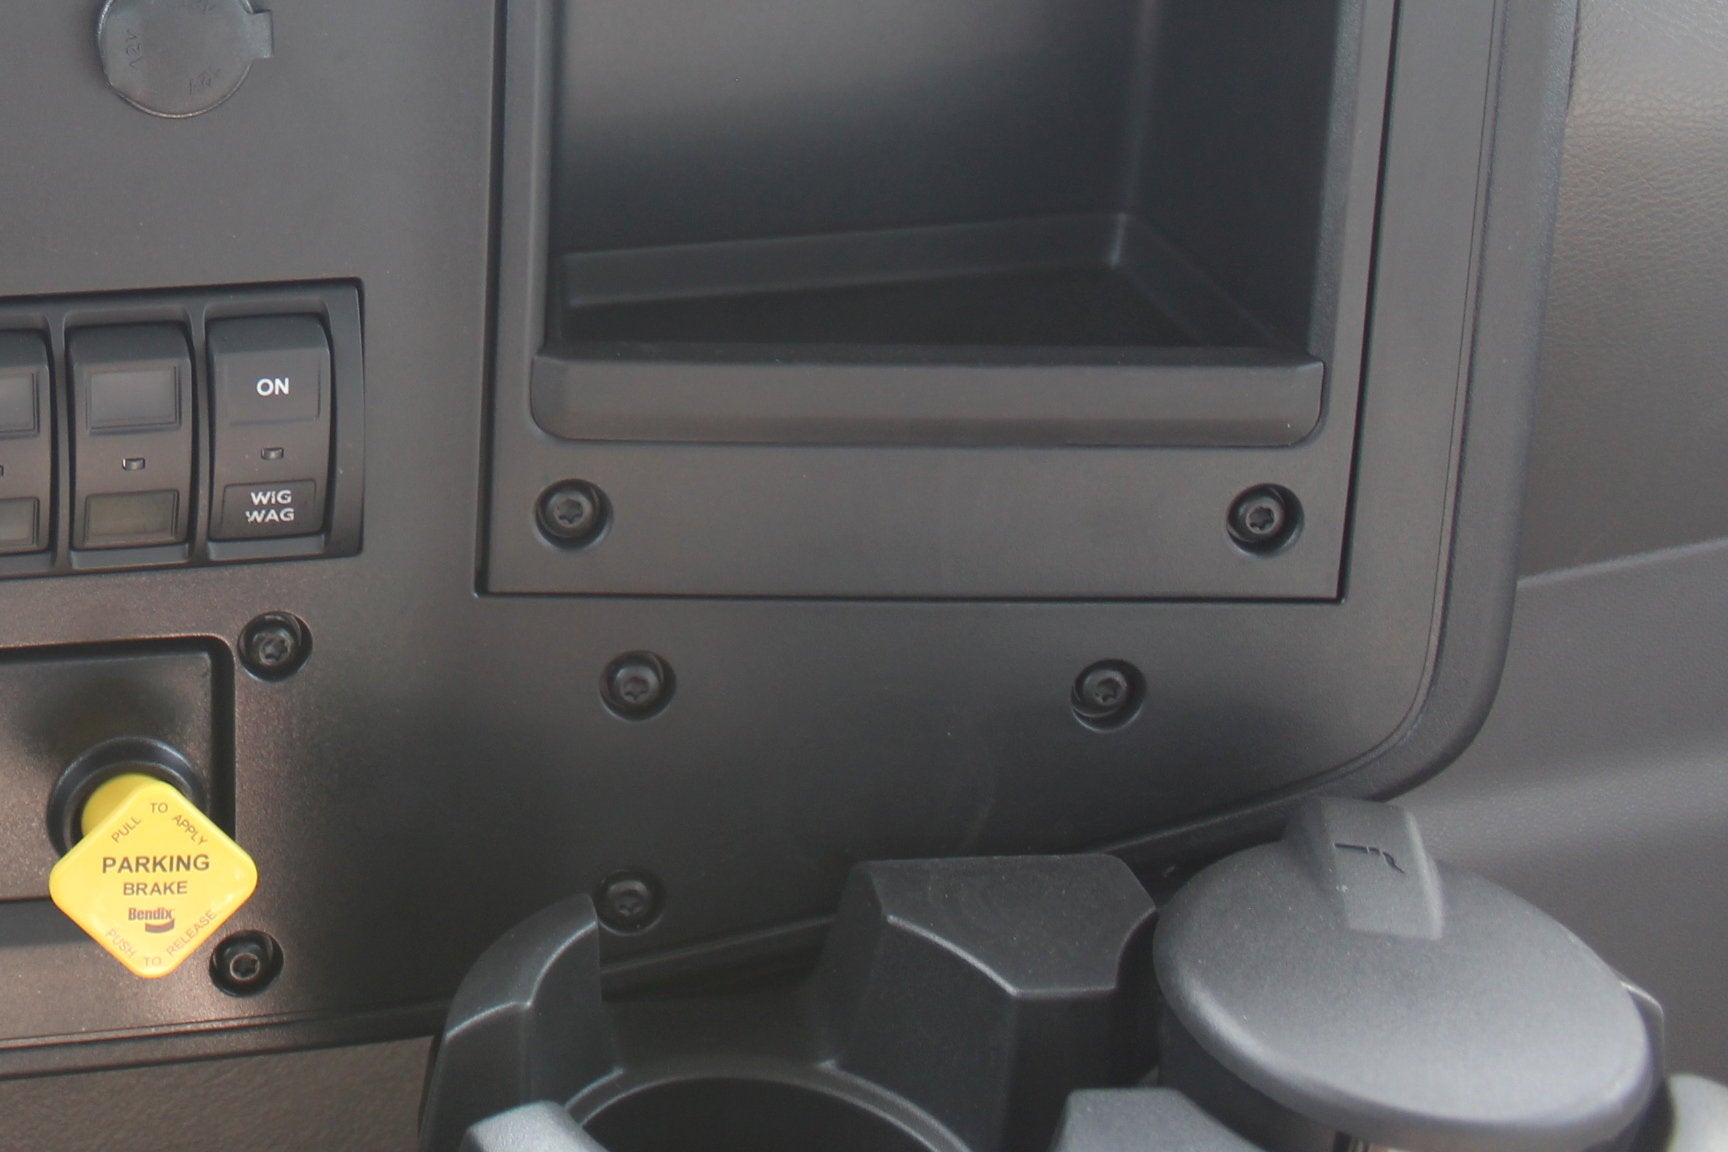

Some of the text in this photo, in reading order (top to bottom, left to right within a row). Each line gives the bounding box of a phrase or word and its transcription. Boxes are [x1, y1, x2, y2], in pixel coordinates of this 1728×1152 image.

[256, 378, 290, 396] ON
[250, 490, 292, 505] WIG
[245, 507, 295, 523] WAG
[111, 802, 208, 846] PULL TO APPLY
[102, 854, 210, 874] PARKING
[123, 880, 188, 896] BRAKE
[128, 907, 174, 921] Bendix
[105, 909, 217, 967] PUSH TO RELEASE
